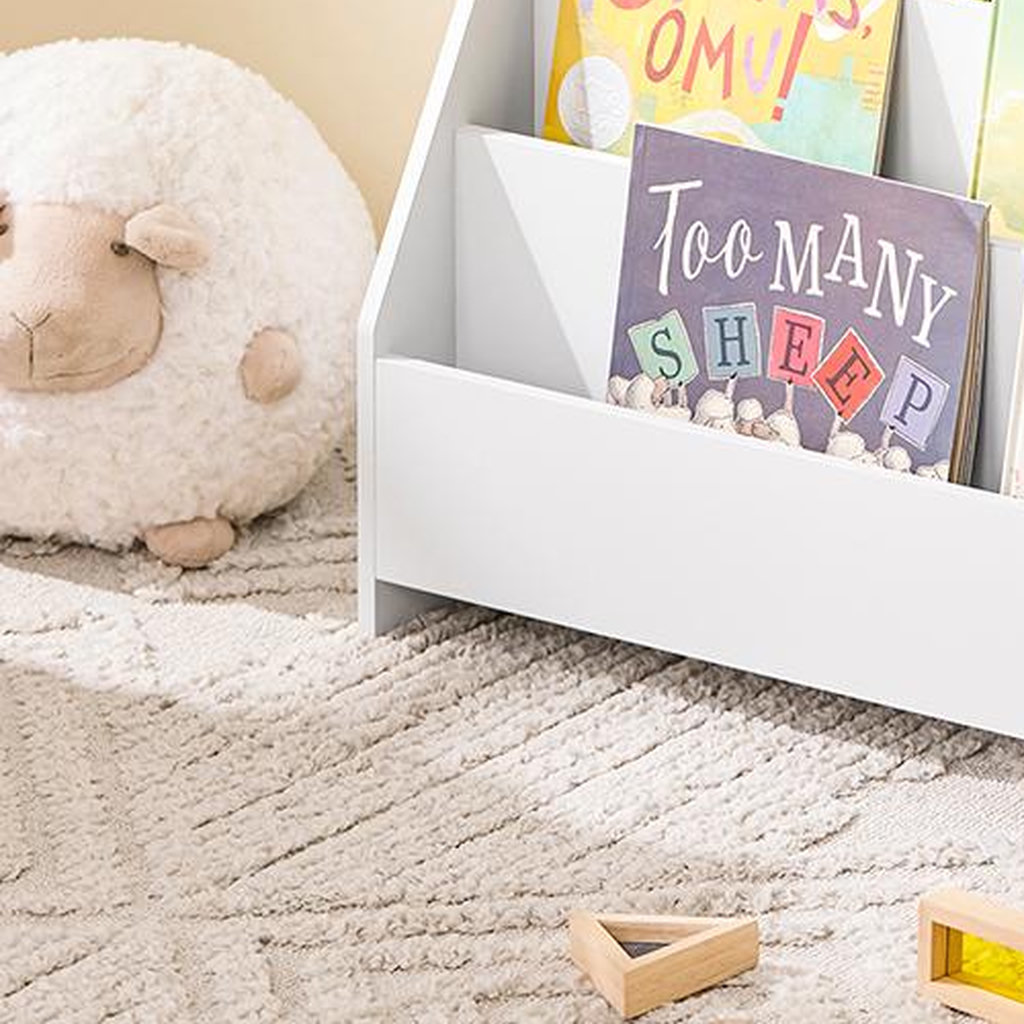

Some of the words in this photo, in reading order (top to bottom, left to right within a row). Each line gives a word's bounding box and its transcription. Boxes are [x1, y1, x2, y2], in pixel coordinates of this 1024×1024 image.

[644, 8, 814, 122] OMU!
[648, 180, 764, 296] Too
[769, 213, 958, 349] MANY
[650, 315, 933, 426] SHEEP
